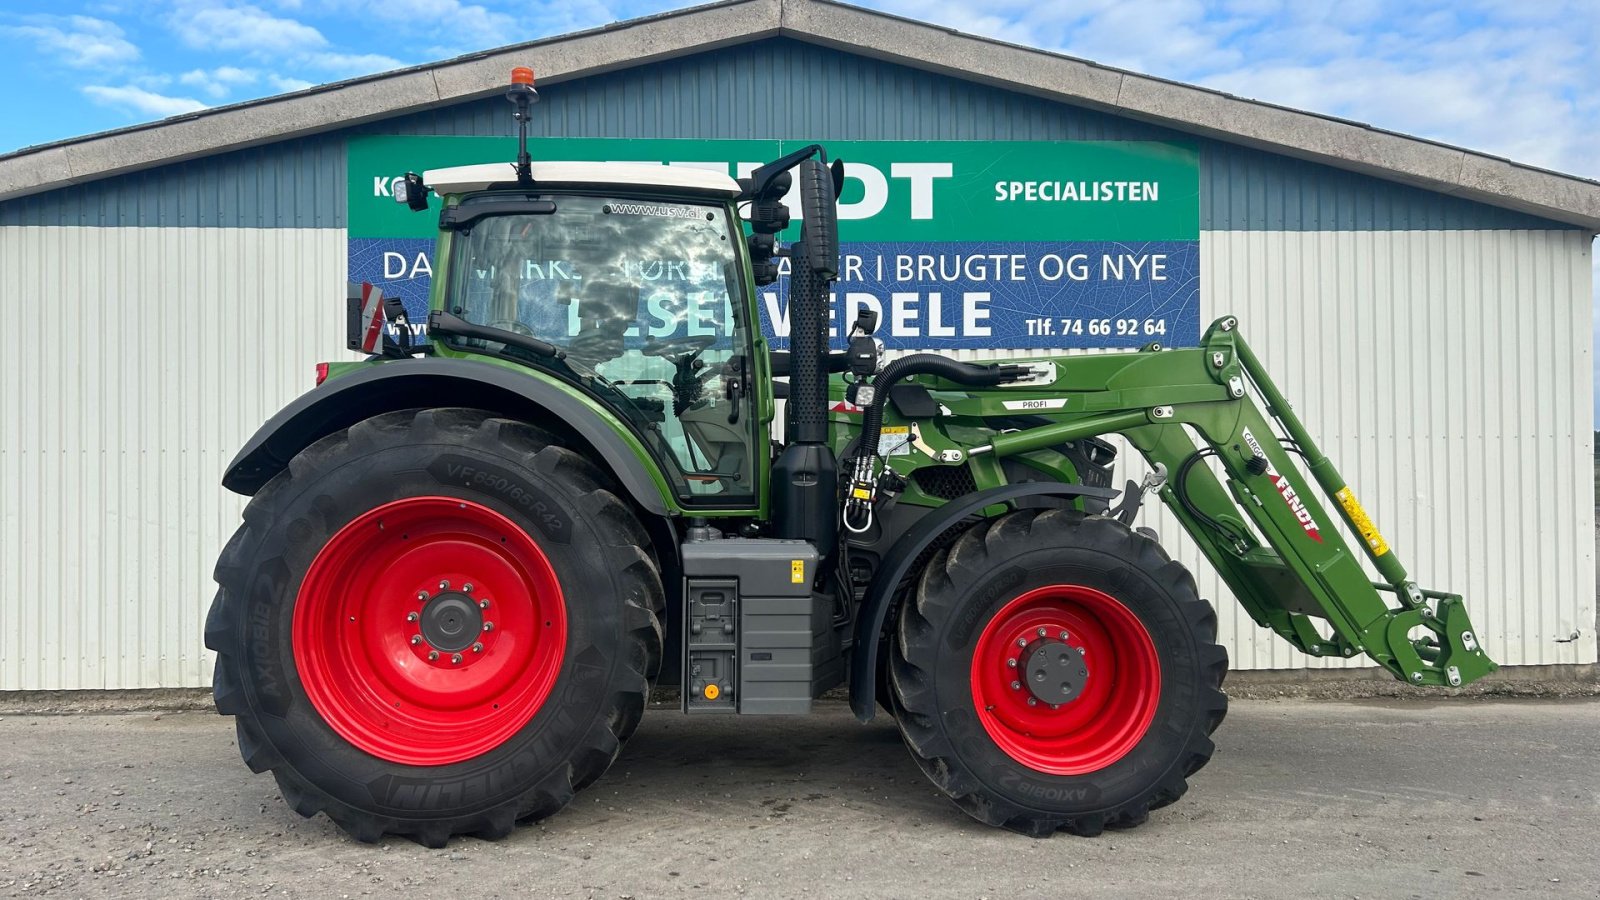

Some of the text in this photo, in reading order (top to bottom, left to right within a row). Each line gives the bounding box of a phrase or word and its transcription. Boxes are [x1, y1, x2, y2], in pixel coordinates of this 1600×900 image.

[995, 181, 1159, 201] SPECIALISTEN
[609, 203, 707, 219] www.usv.dk
[876, 254, 883, 281] I
[896, 254, 1026, 281] BRUGTE
[1039, 254, 1089, 281] OG
[1102, 254, 1167, 281] NYE
[1025, 318, 1166, 335] Tlf. 74 66 92 64
[1022, 400, 1047, 409] PROFI
[1244, 432, 1264, 458] CARGO
[1275, 475, 1320, 531] FENDT
